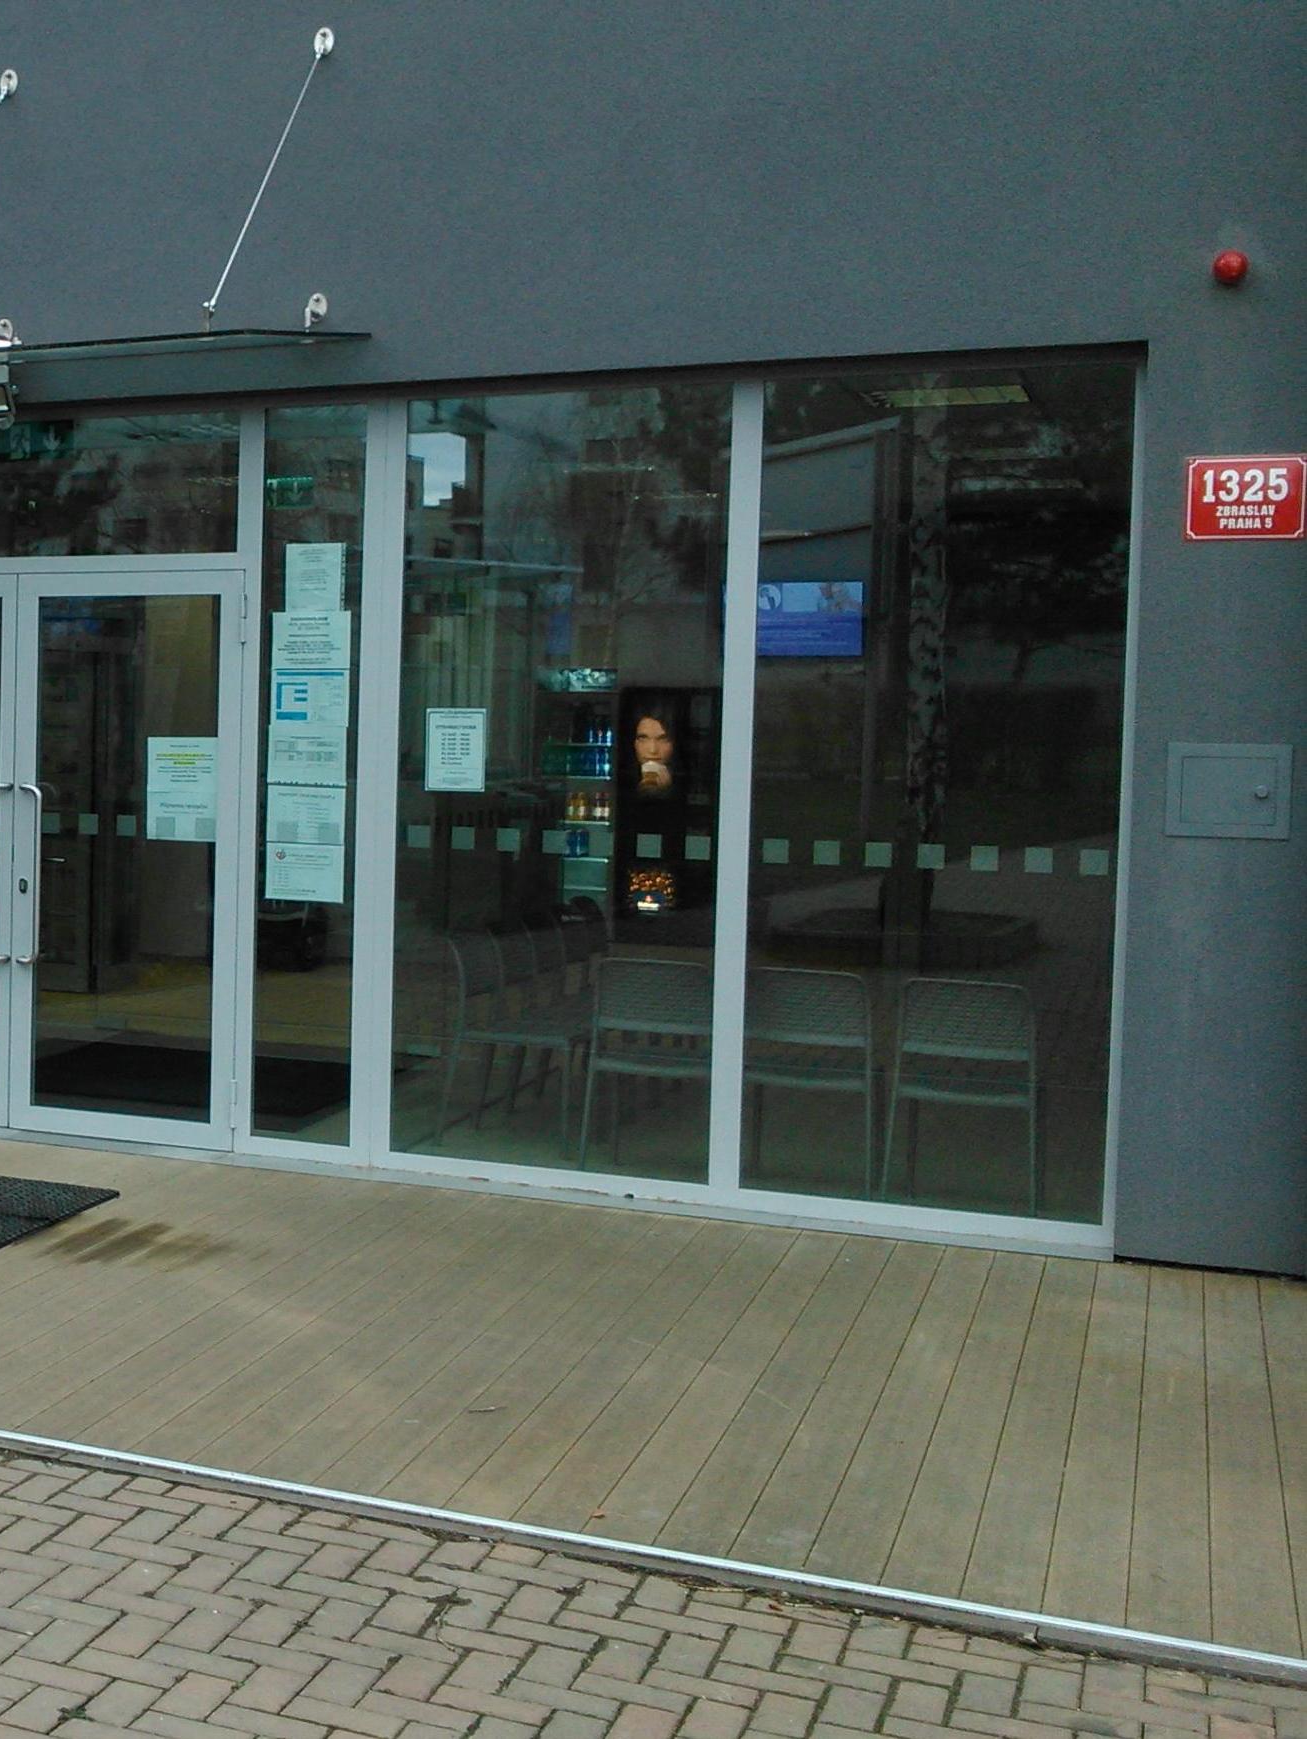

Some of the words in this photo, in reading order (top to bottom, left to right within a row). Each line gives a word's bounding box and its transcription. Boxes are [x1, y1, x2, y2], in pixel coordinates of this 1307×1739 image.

[1203, 468, 1289, 503] 1325
[1215, 504, 1276, 517] ZBRASLAV
[1219, 518, 1261, 529] PRAHA
[1264, 517, 1273, 528] 5
